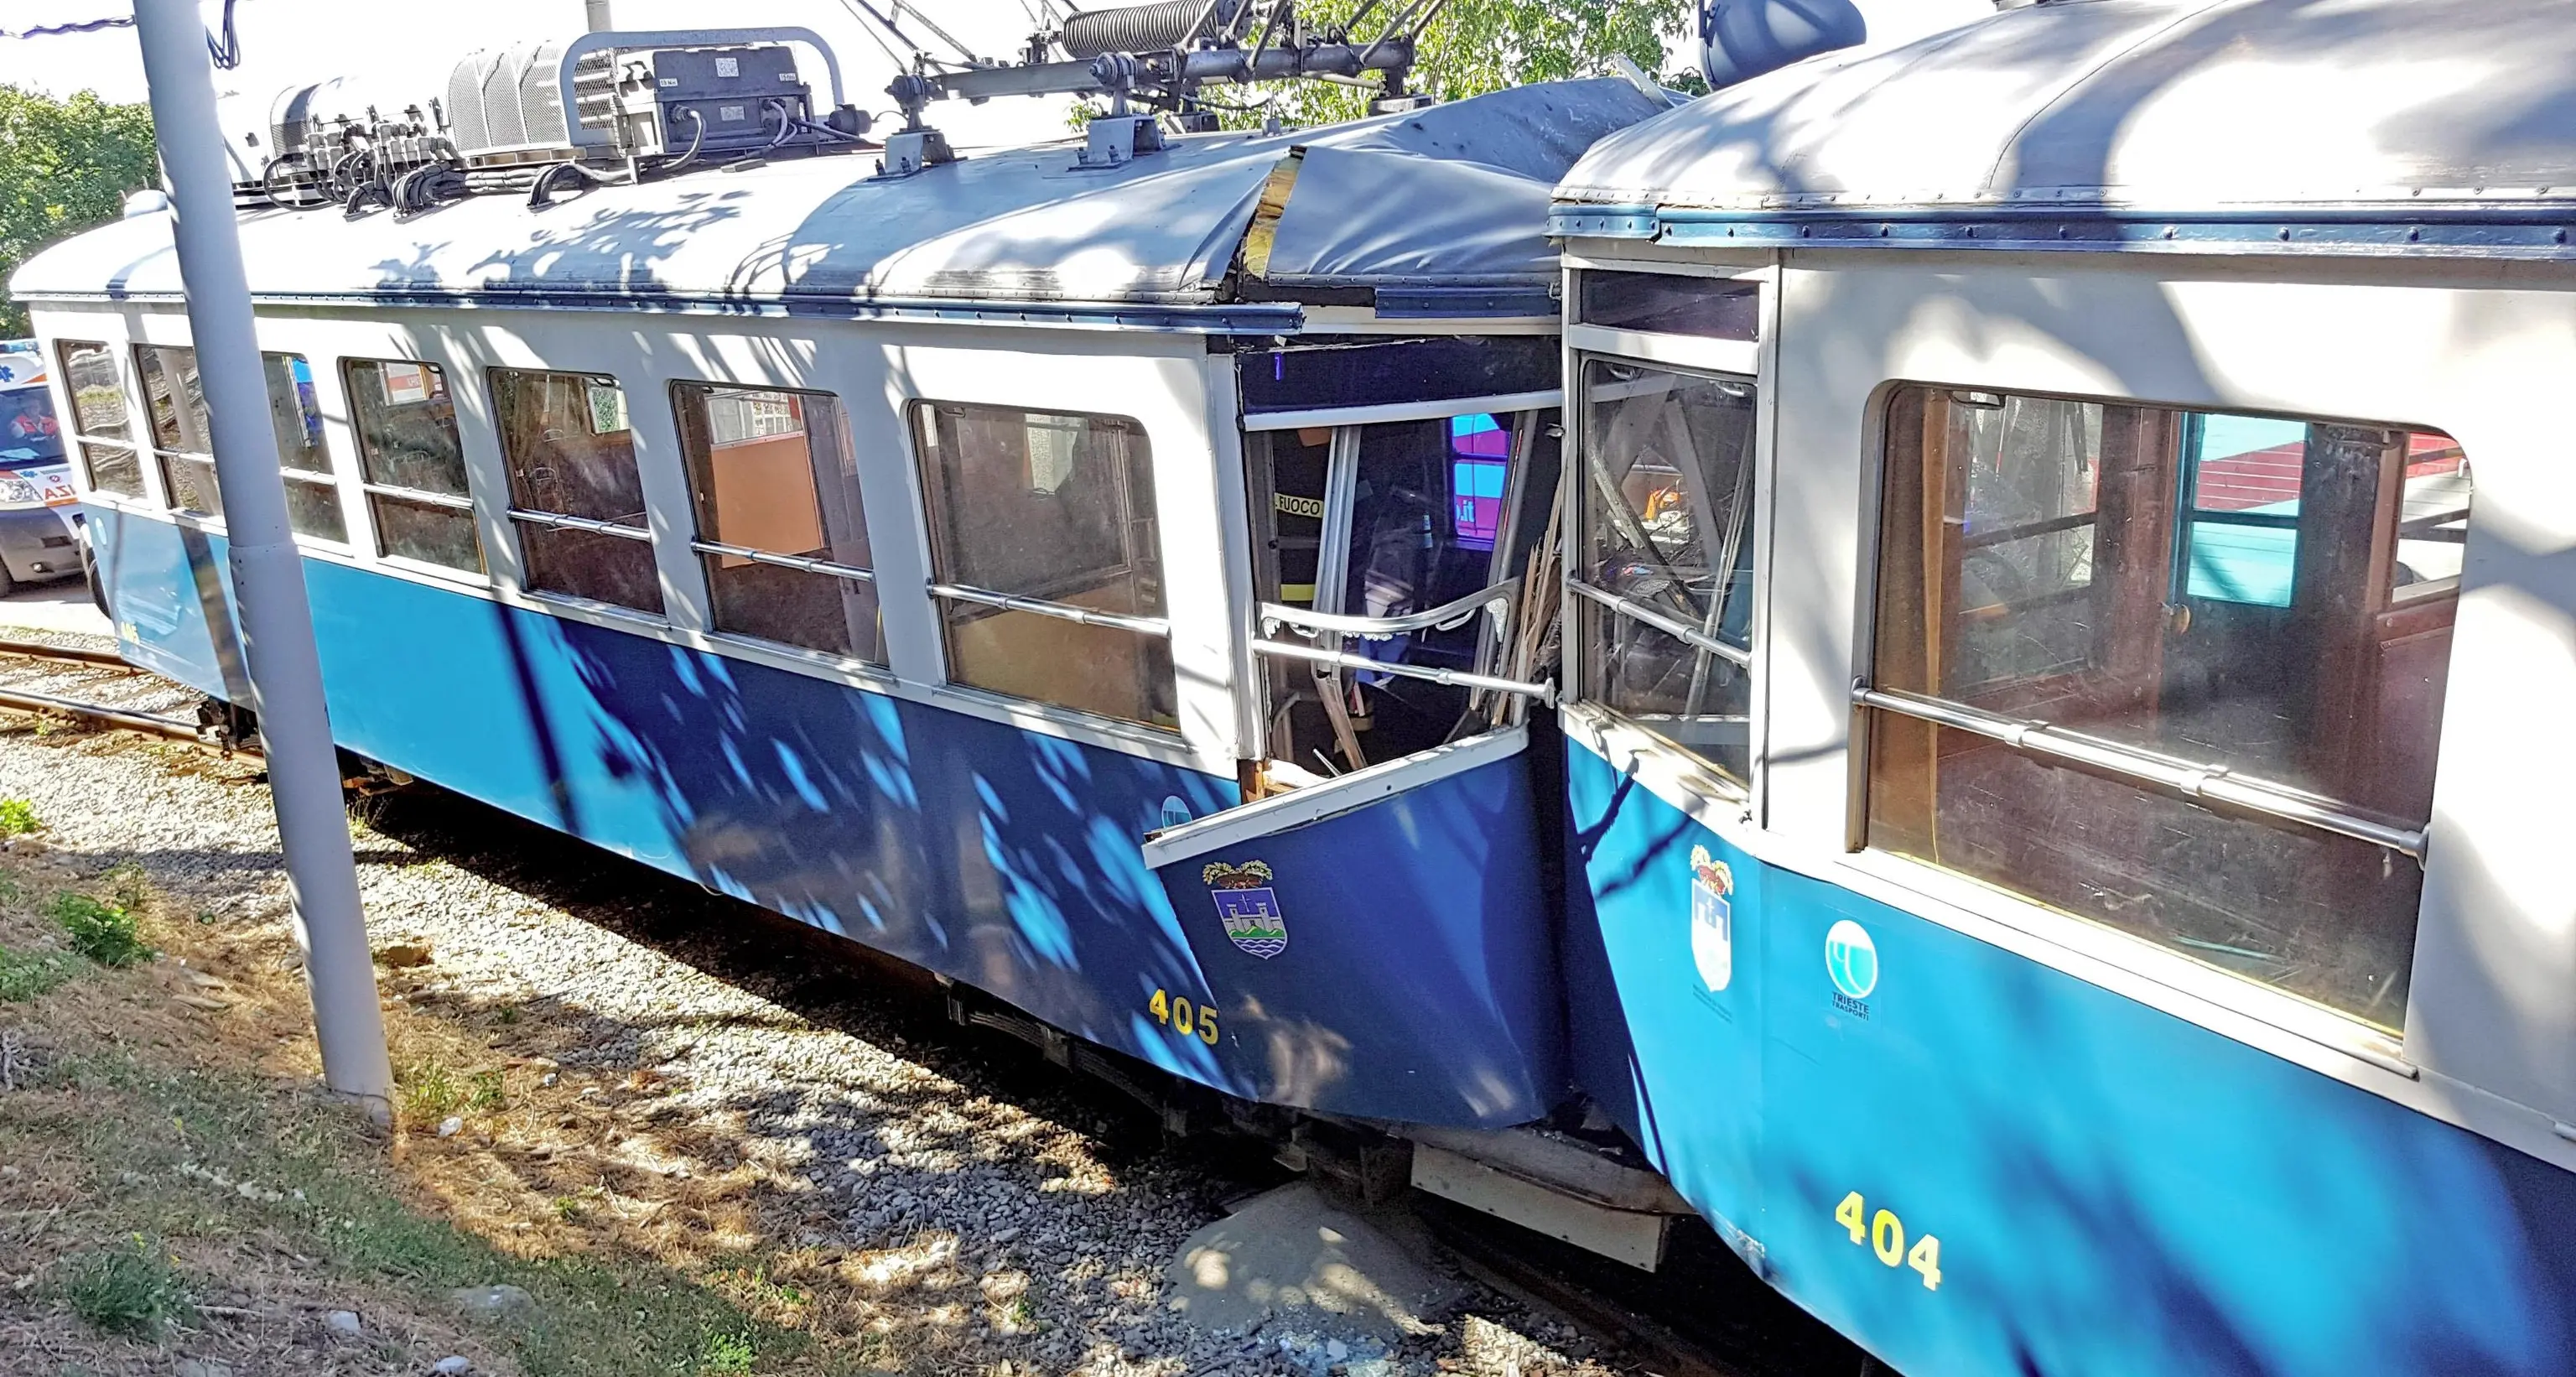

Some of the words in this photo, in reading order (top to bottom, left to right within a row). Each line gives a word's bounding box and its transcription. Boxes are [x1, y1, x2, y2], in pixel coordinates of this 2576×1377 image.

[1279, 496, 1321, 516] FUOCO
[1832, 991, 1870, 1014] TRIESTE
[1832, 1000, 1869, 1021] TRASPORTI
[1149, 988, 1219, 1045] 405
[1835, 1190, 1942, 1291] 404
